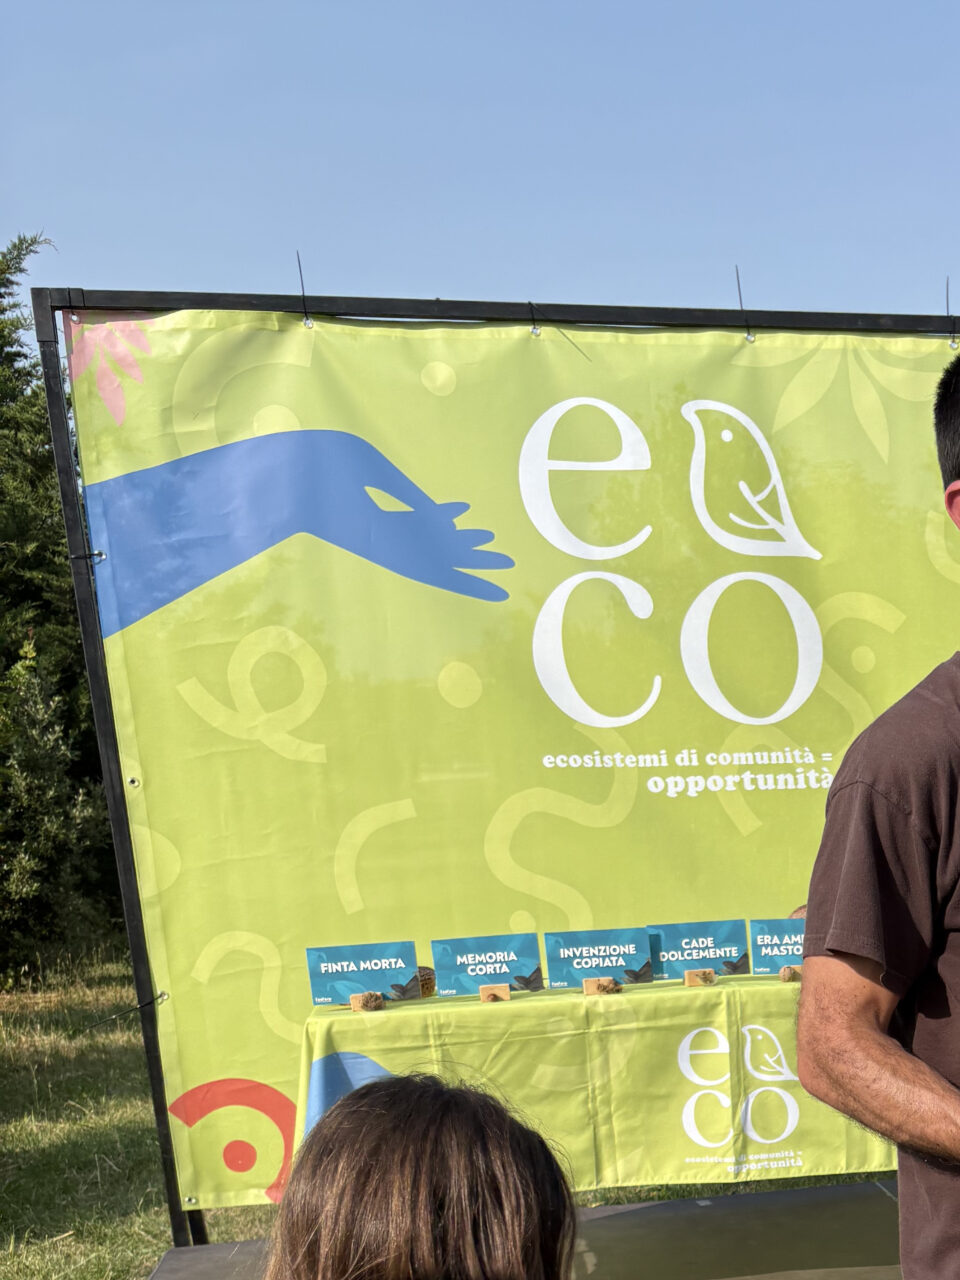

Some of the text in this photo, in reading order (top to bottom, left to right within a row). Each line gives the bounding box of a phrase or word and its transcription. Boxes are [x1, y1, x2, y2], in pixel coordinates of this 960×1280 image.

[542, 750, 669, 768] ecosistemi
[675, 749, 699, 766] di
[705, 747, 815, 766] comunità
[646, 767, 835, 797] opportunità
[681, 937, 715, 949] CADE
[757, 935, 780, 945] ERA
[559, 944, 637, 959] INVENZIONE
[659, 947, 739, 962] DOLCEMENTE
[761, 945, 804, 956] MASTO
[320, 957, 406, 974] FINTA MORTA
[456, 951, 518, 966] MEMORIA
[573, 956, 626, 969] COPIATA
[467, 963, 510, 976] CORTA
